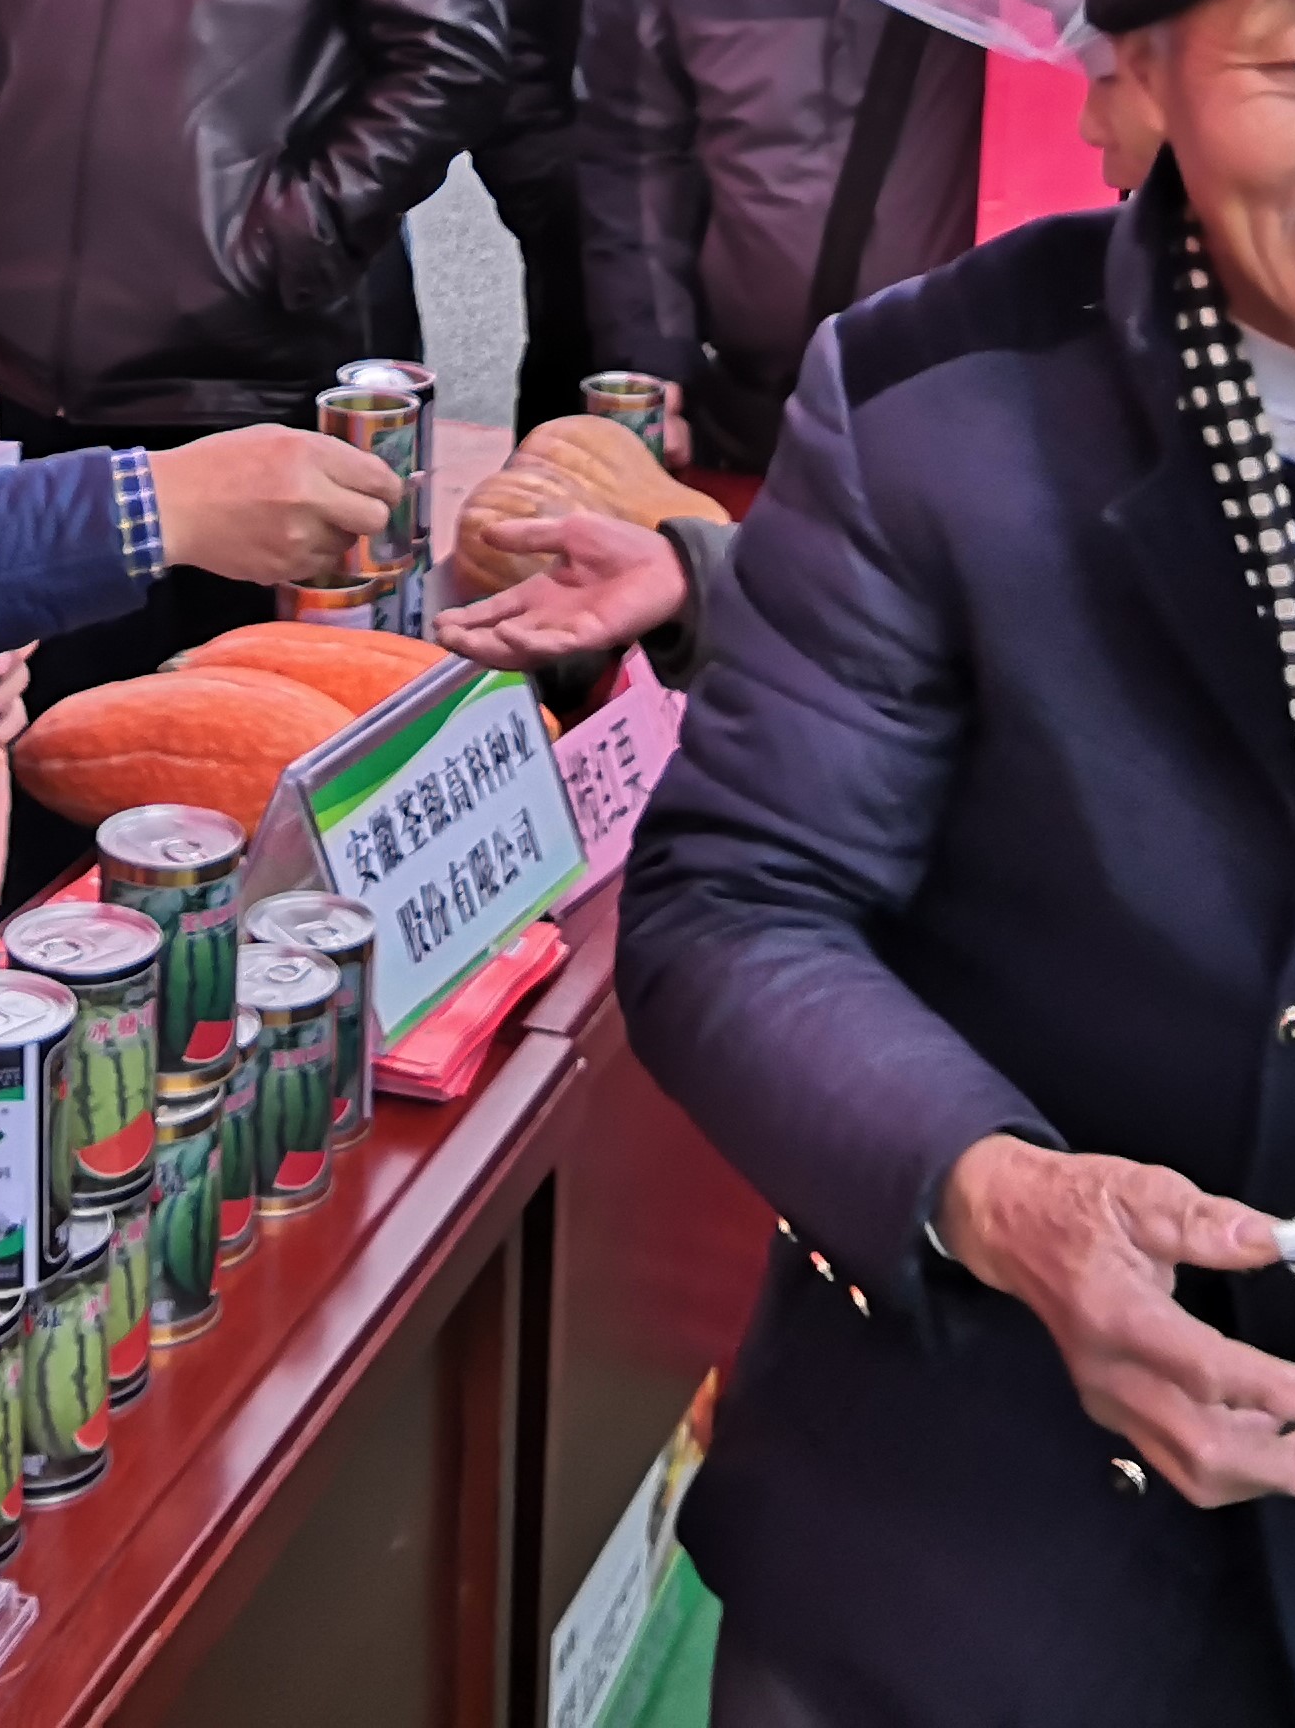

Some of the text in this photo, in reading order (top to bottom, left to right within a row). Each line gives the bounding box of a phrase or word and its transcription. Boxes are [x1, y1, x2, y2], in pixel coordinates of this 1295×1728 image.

[394, 806, 543, 964] 股份有限公司
